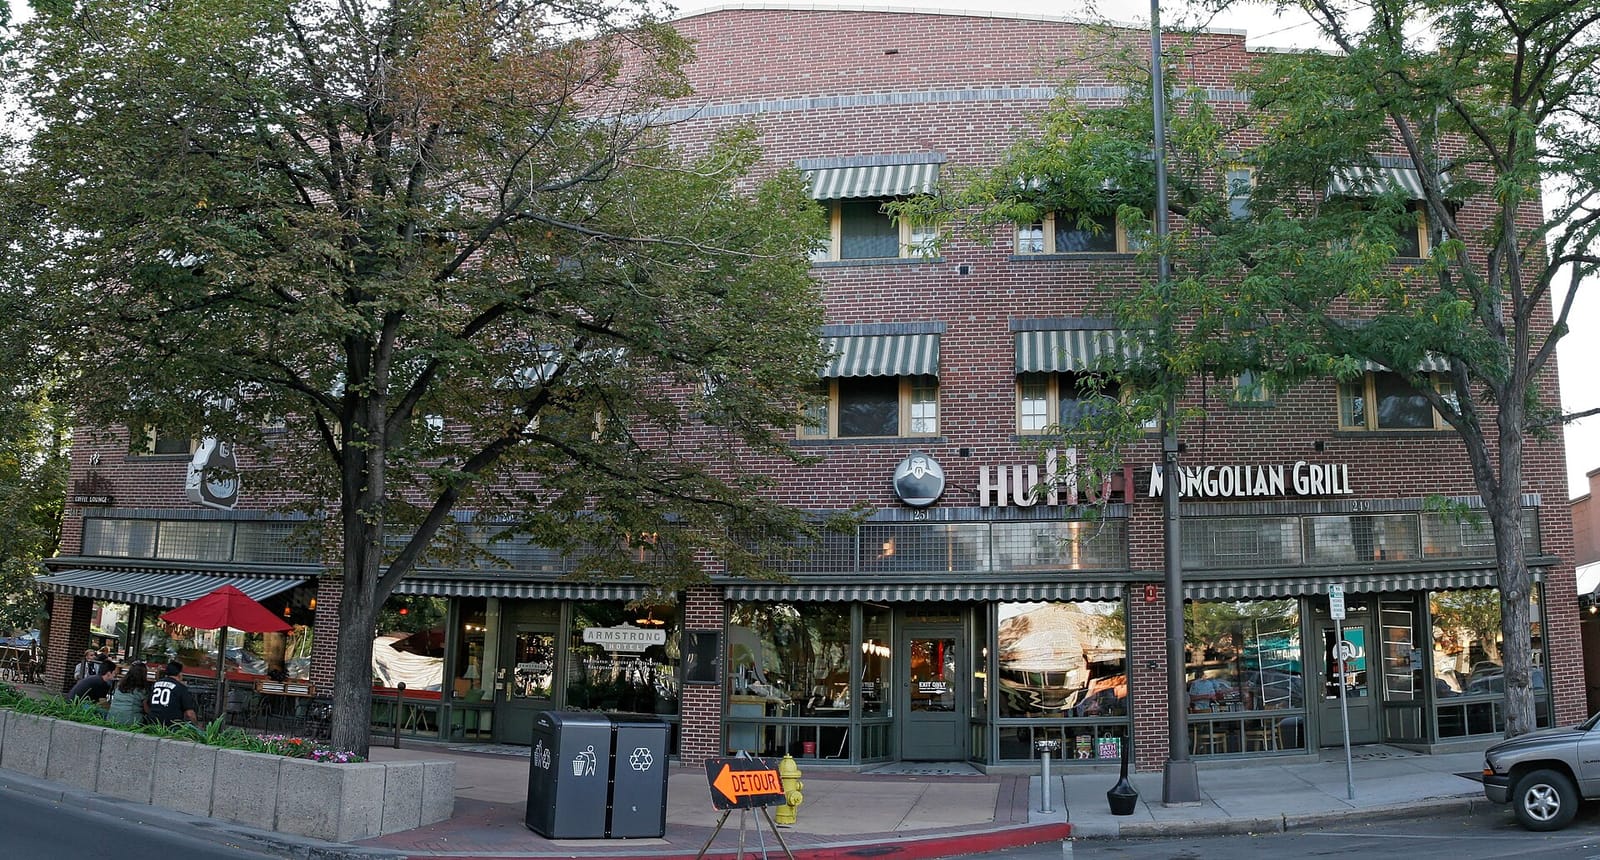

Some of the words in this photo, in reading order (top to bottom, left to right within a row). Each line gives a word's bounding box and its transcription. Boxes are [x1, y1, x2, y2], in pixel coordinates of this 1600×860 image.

[1149, 462, 1285, 497] MONGOLIAN
[1292, 460, 1354, 495] GRILL
[914, 509, 929, 520] 251
[588, 631, 660, 641] ARMSTRONG
[931, 681, 947, 689] ONLY
[151, 687, 171, 705] 20
[731, 773, 777, 793] DETOUR
